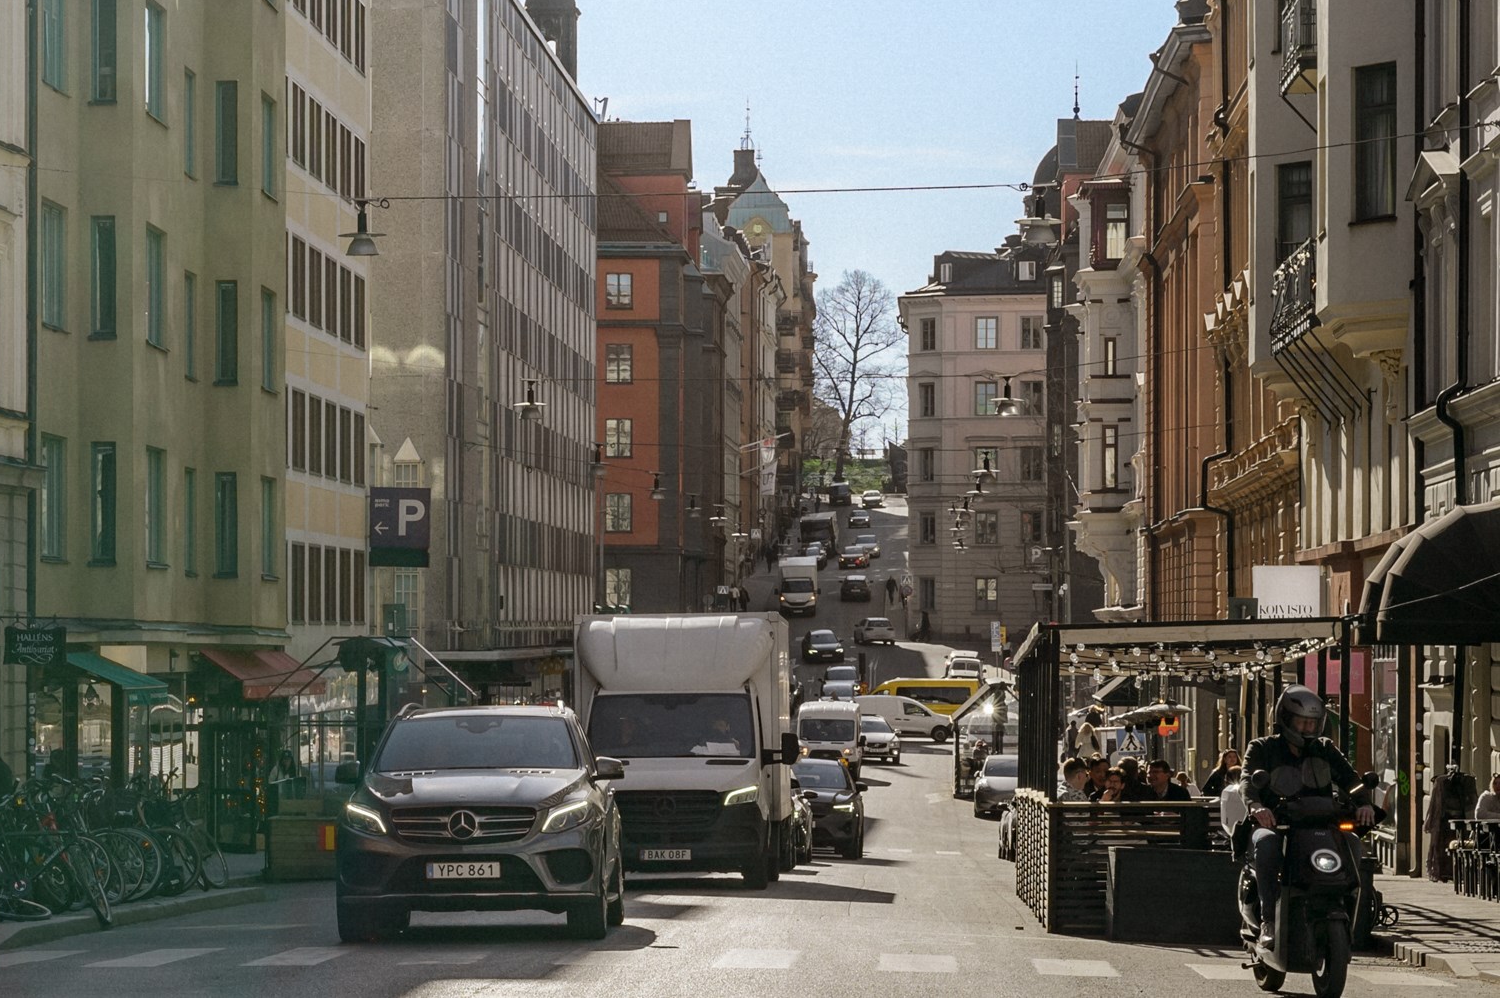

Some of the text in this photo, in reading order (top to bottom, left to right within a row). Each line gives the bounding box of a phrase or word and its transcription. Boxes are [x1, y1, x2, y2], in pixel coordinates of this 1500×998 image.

[398, 499, 425, 536] P
[1260, 605, 1313, 615] KOIVISTO
[648, 850, 665, 859] BAK
[438, 864, 493, 877] YPC 861
